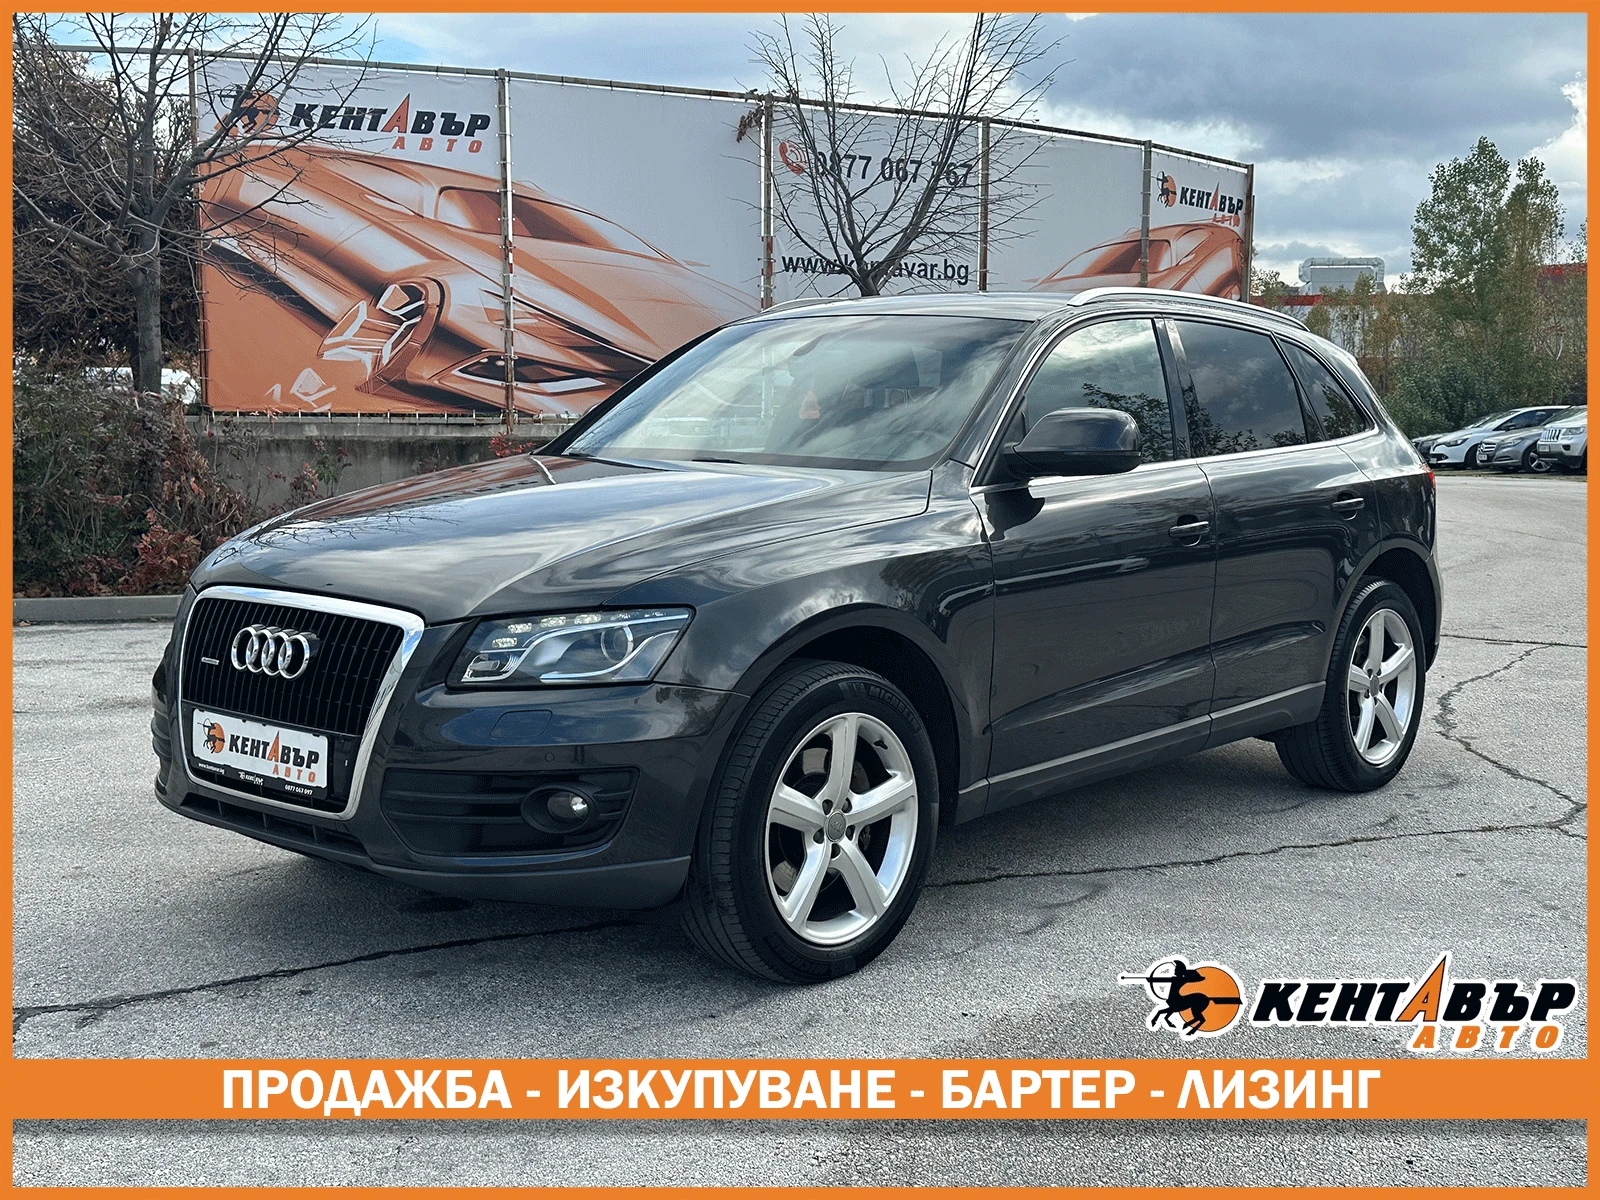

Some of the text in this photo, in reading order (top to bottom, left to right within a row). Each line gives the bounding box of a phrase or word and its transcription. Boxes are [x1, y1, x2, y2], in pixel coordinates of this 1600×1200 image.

[289, 92, 491, 137] КЕНТАВЪР
[392, 136, 482, 153] АВТО
[881, 156, 923, 183] 067
[1180, 182, 1244, 214] КЕНТАВЪР
[782, 254, 969, 285] www.kavar.bg
[228, 731, 320, 769] КЕНТАВЪР
[272, 764, 316, 783] АВТО
